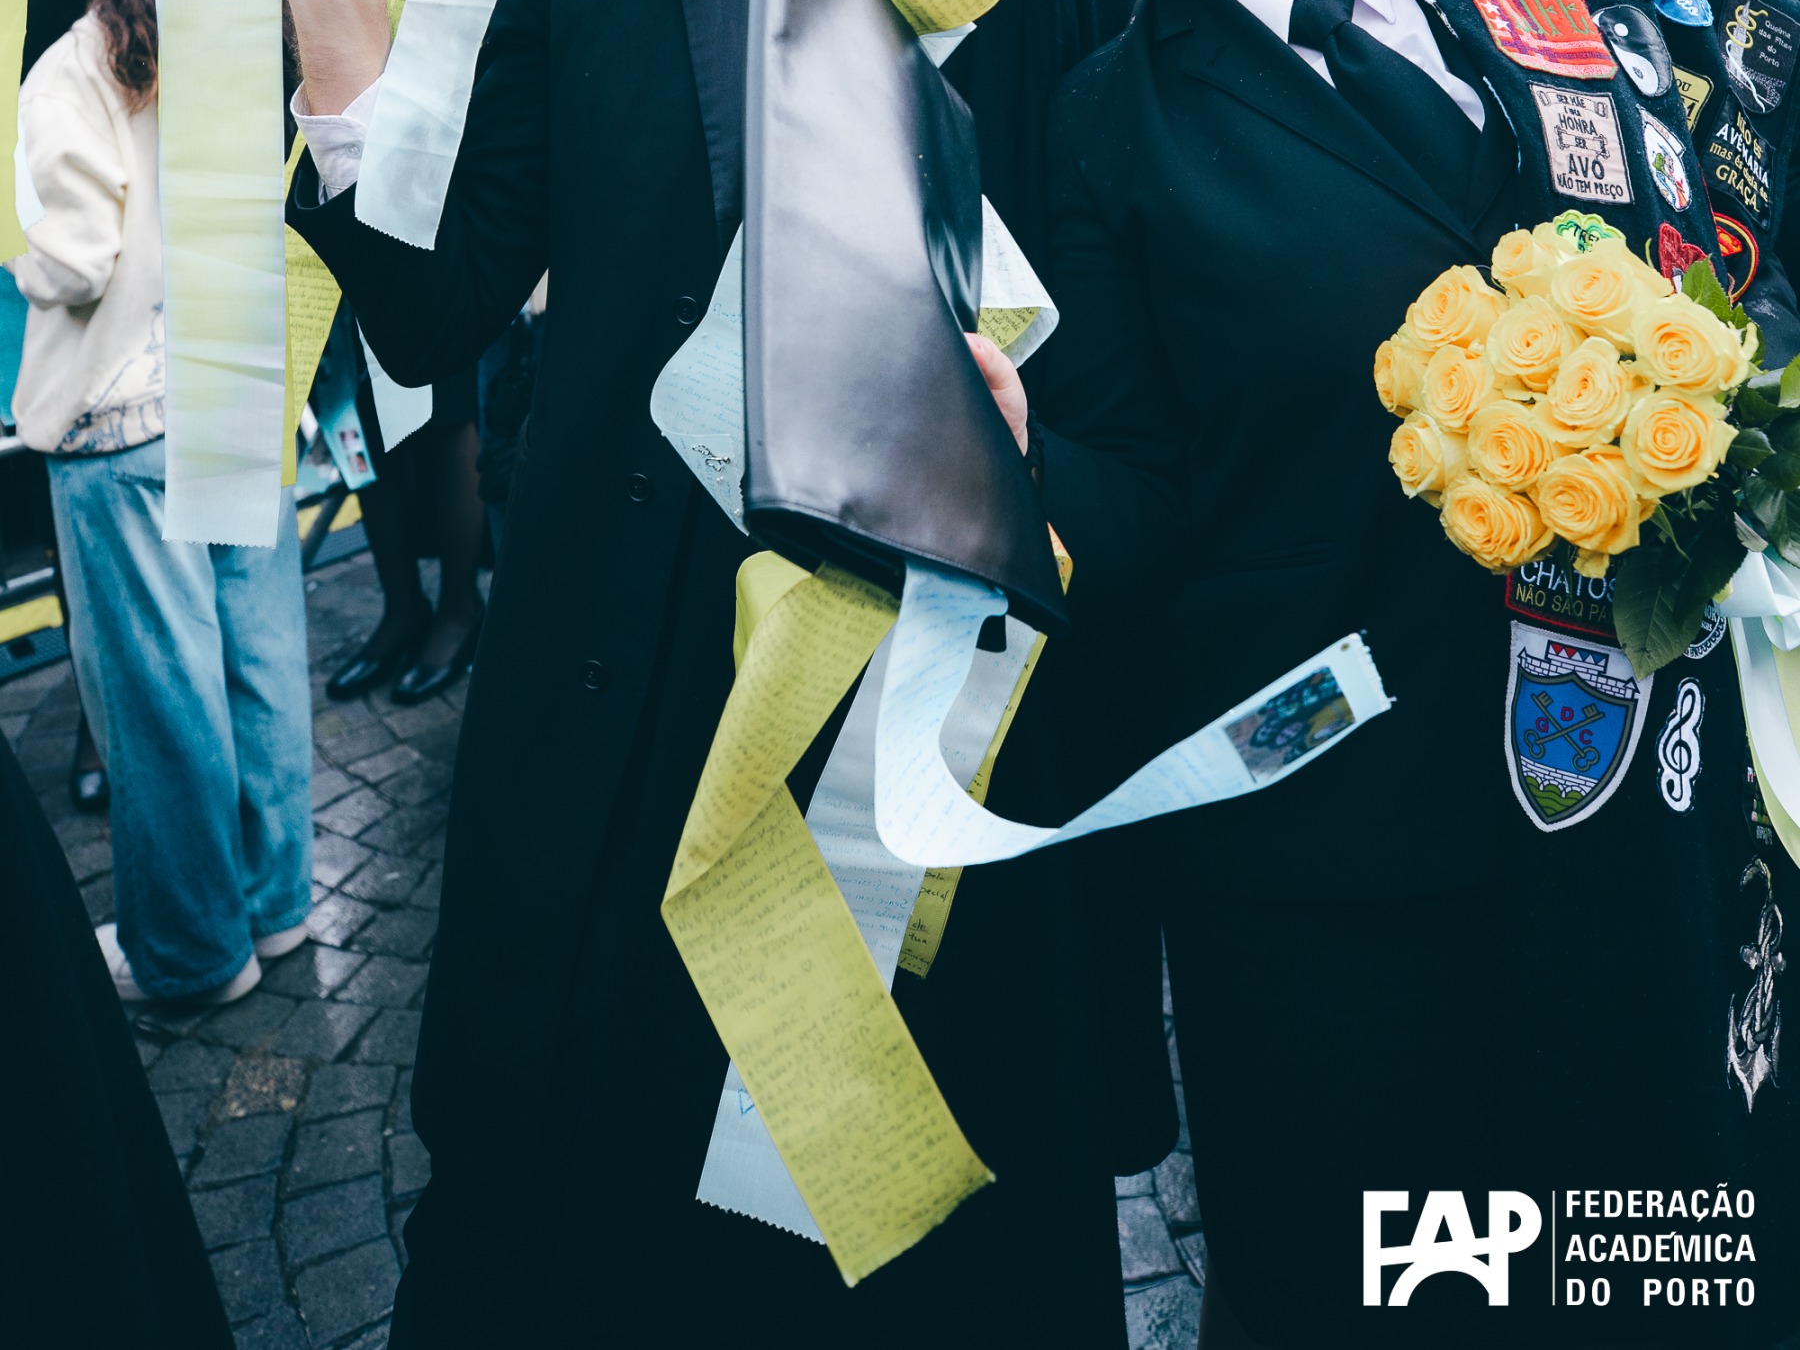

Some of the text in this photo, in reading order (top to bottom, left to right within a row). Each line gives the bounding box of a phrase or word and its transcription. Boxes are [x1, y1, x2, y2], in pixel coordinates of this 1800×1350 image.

[1764, 19, 1792, 39] Queima
[1758, 28, 1793, 51] das Fitas
[1767, 44, 1777, 55] do
[1759, 51, 1780, 68] Porto
[1558, 113, 1598, 136] HONRA
[1574, 137, 1587, 149] SER
[1709, 142, 1734, 161] mas
[1556, 173, 1624, 199] NÃO TEM PREÇO
[1715, 164, 1760, 213] GRAÇA
[1515, 583, 1547, 607] NÃO
[1560, 706, 1574, 721] D
[1536, 717, 1549, 733] G
[1579, 729, 1593, 745] C
